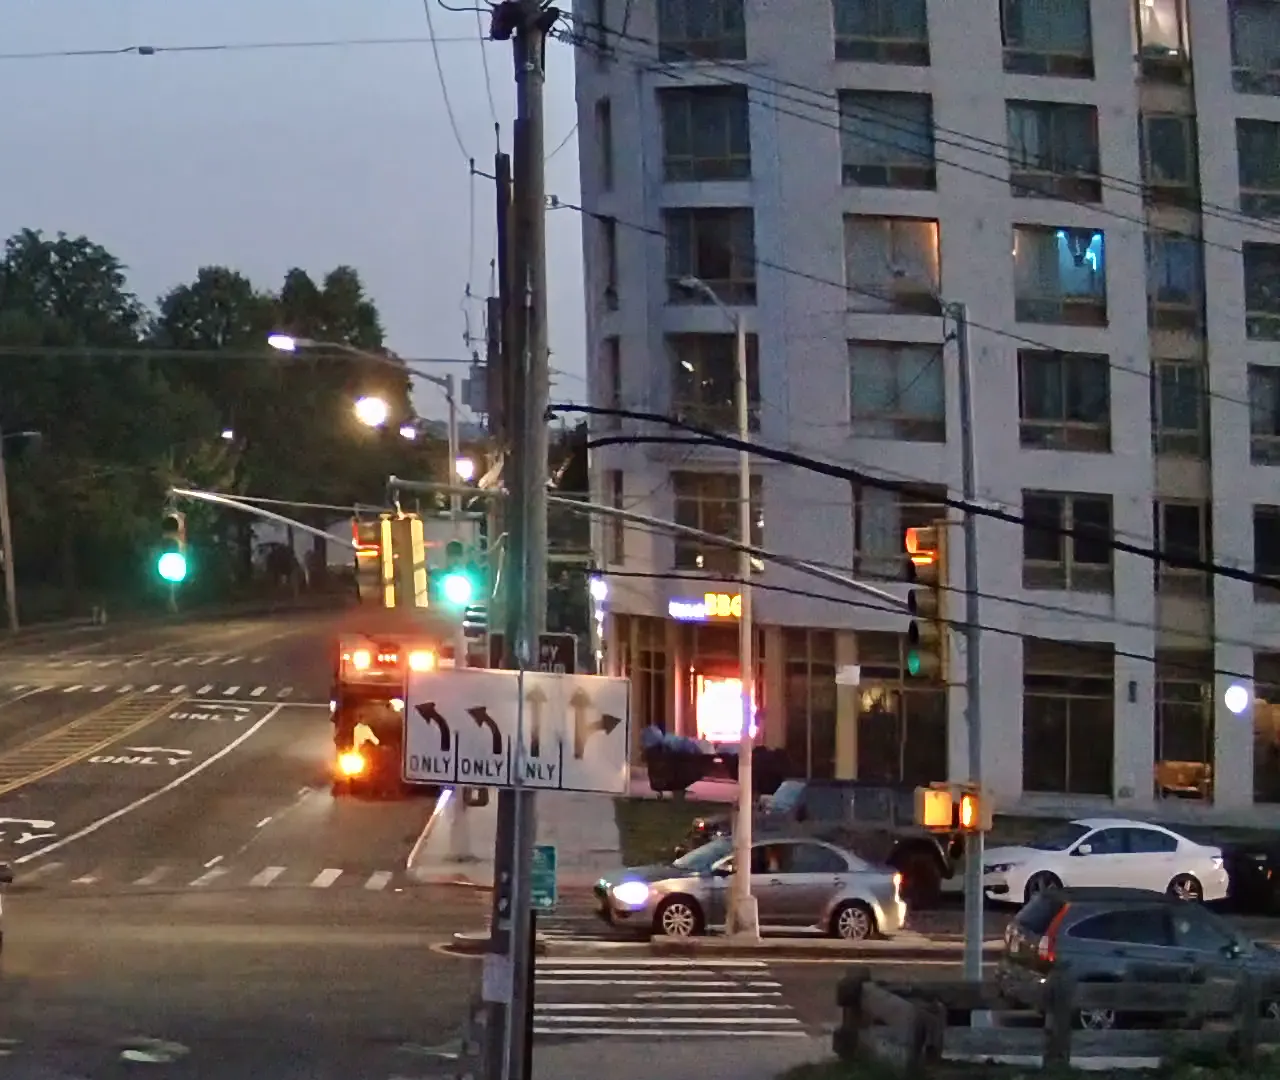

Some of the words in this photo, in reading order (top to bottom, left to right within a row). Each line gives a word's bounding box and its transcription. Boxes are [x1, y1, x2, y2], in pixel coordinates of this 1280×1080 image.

[88, 755, 192, 766] ONLY
[409, 755, 452, 774] ONLY
[461, 758, 504, 777] ONLY
[525, 763, 556, 781] NLY
